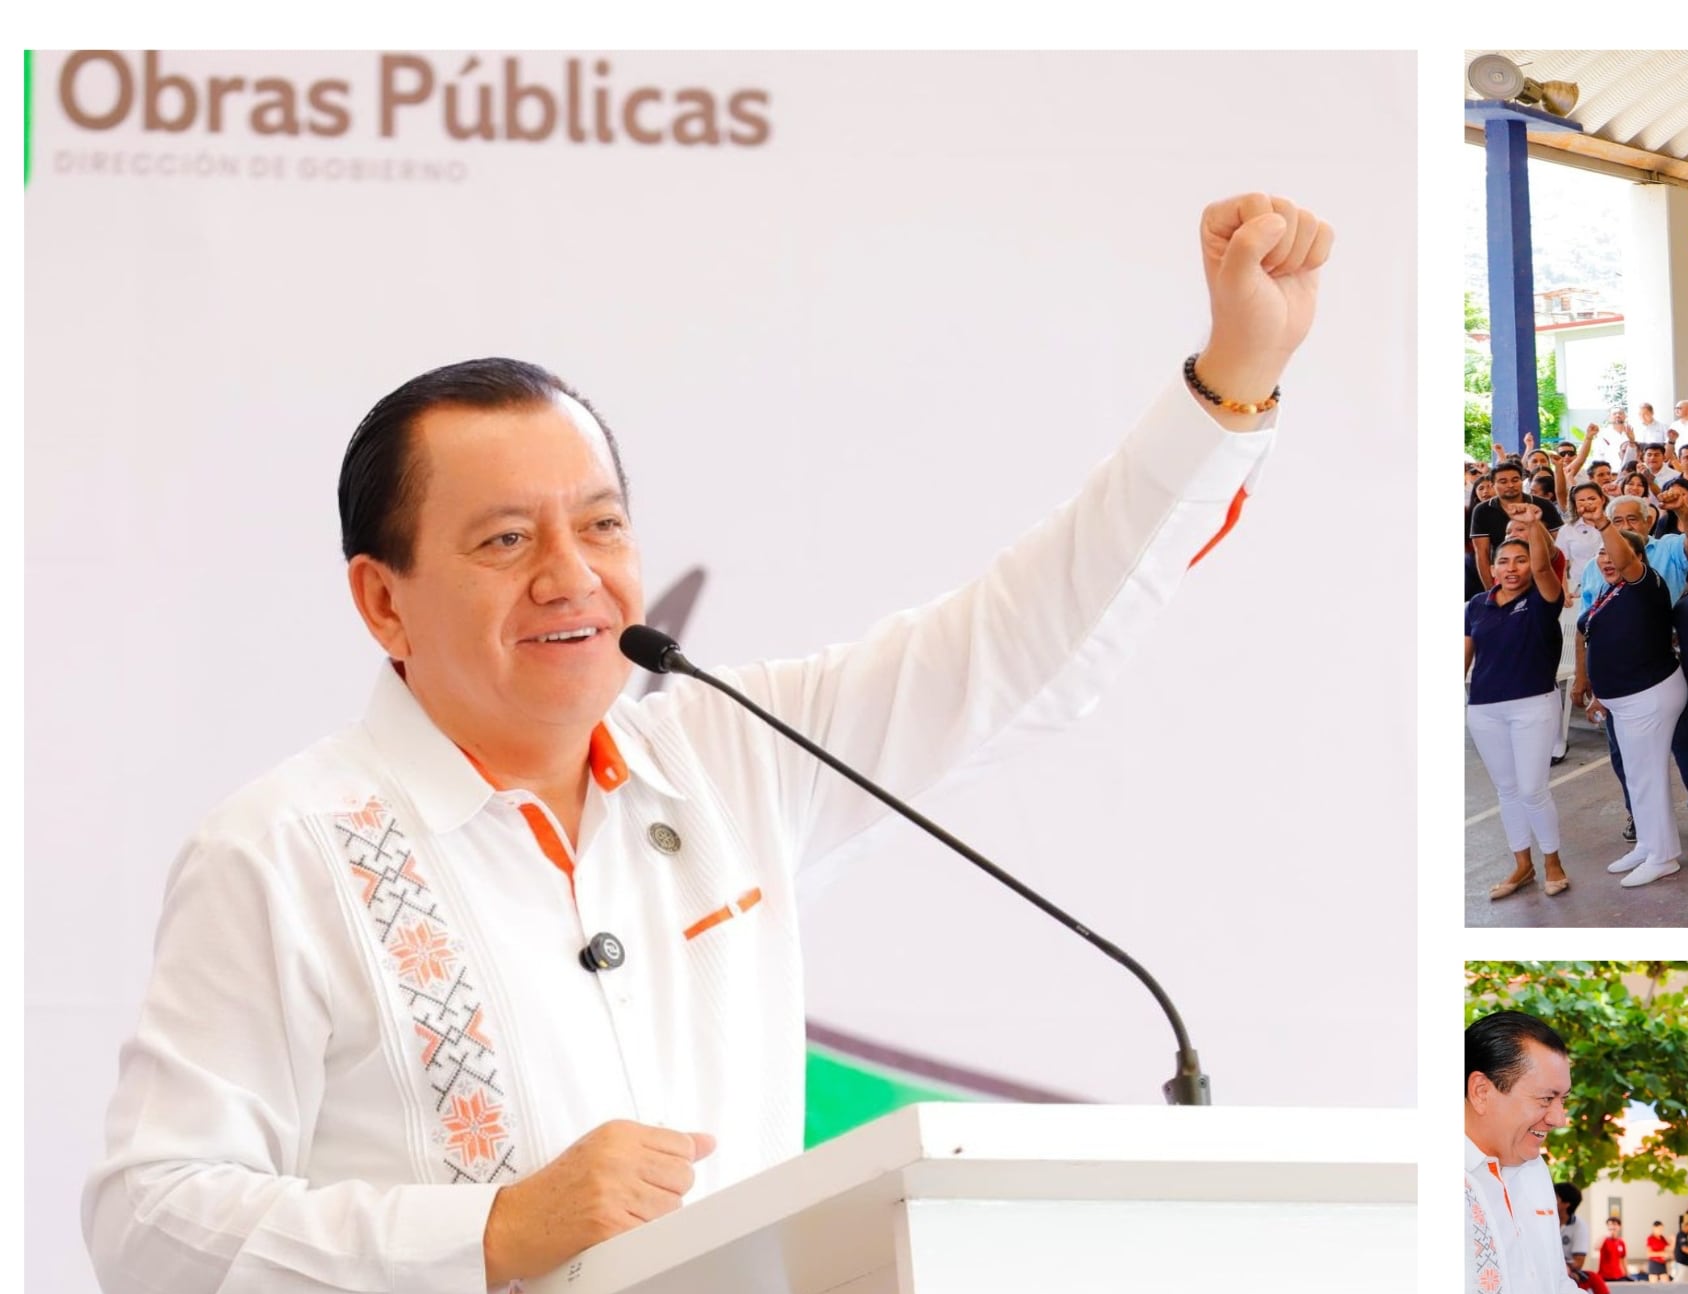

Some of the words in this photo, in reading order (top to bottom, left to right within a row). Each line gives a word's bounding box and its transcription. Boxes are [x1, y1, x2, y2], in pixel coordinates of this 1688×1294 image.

[57, 50, 352, 138] Obras
[378, 54, 773, 149] Públicas
[54, 150, 240, 178] DIRECCIÓN
[250, 154, 287, 180] DE
[298, 155, 468, 184] GOBIERNO
